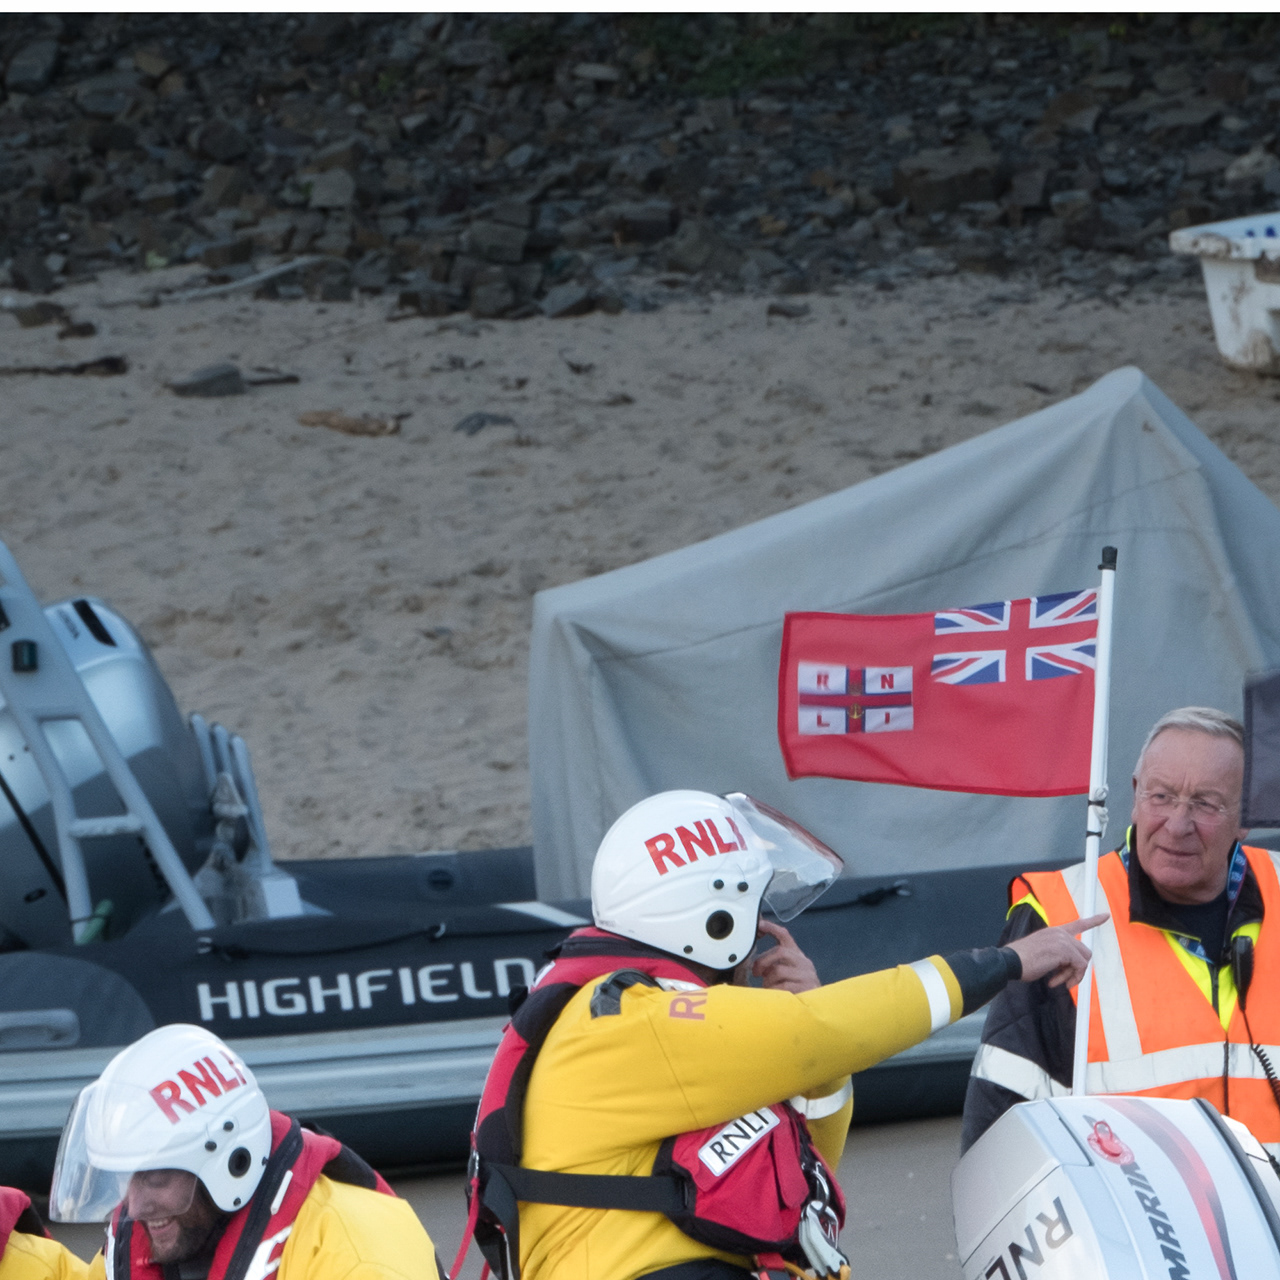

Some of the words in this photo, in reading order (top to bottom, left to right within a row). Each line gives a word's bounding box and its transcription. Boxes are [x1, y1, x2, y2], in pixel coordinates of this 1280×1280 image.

[643, 816, 748, 876] RNLI
[197, 956, 536, 1021] HIGHFIELD
[149, 1048, 248, 1125] RNLI
[709, 1108, 771, 1167] RNLI
